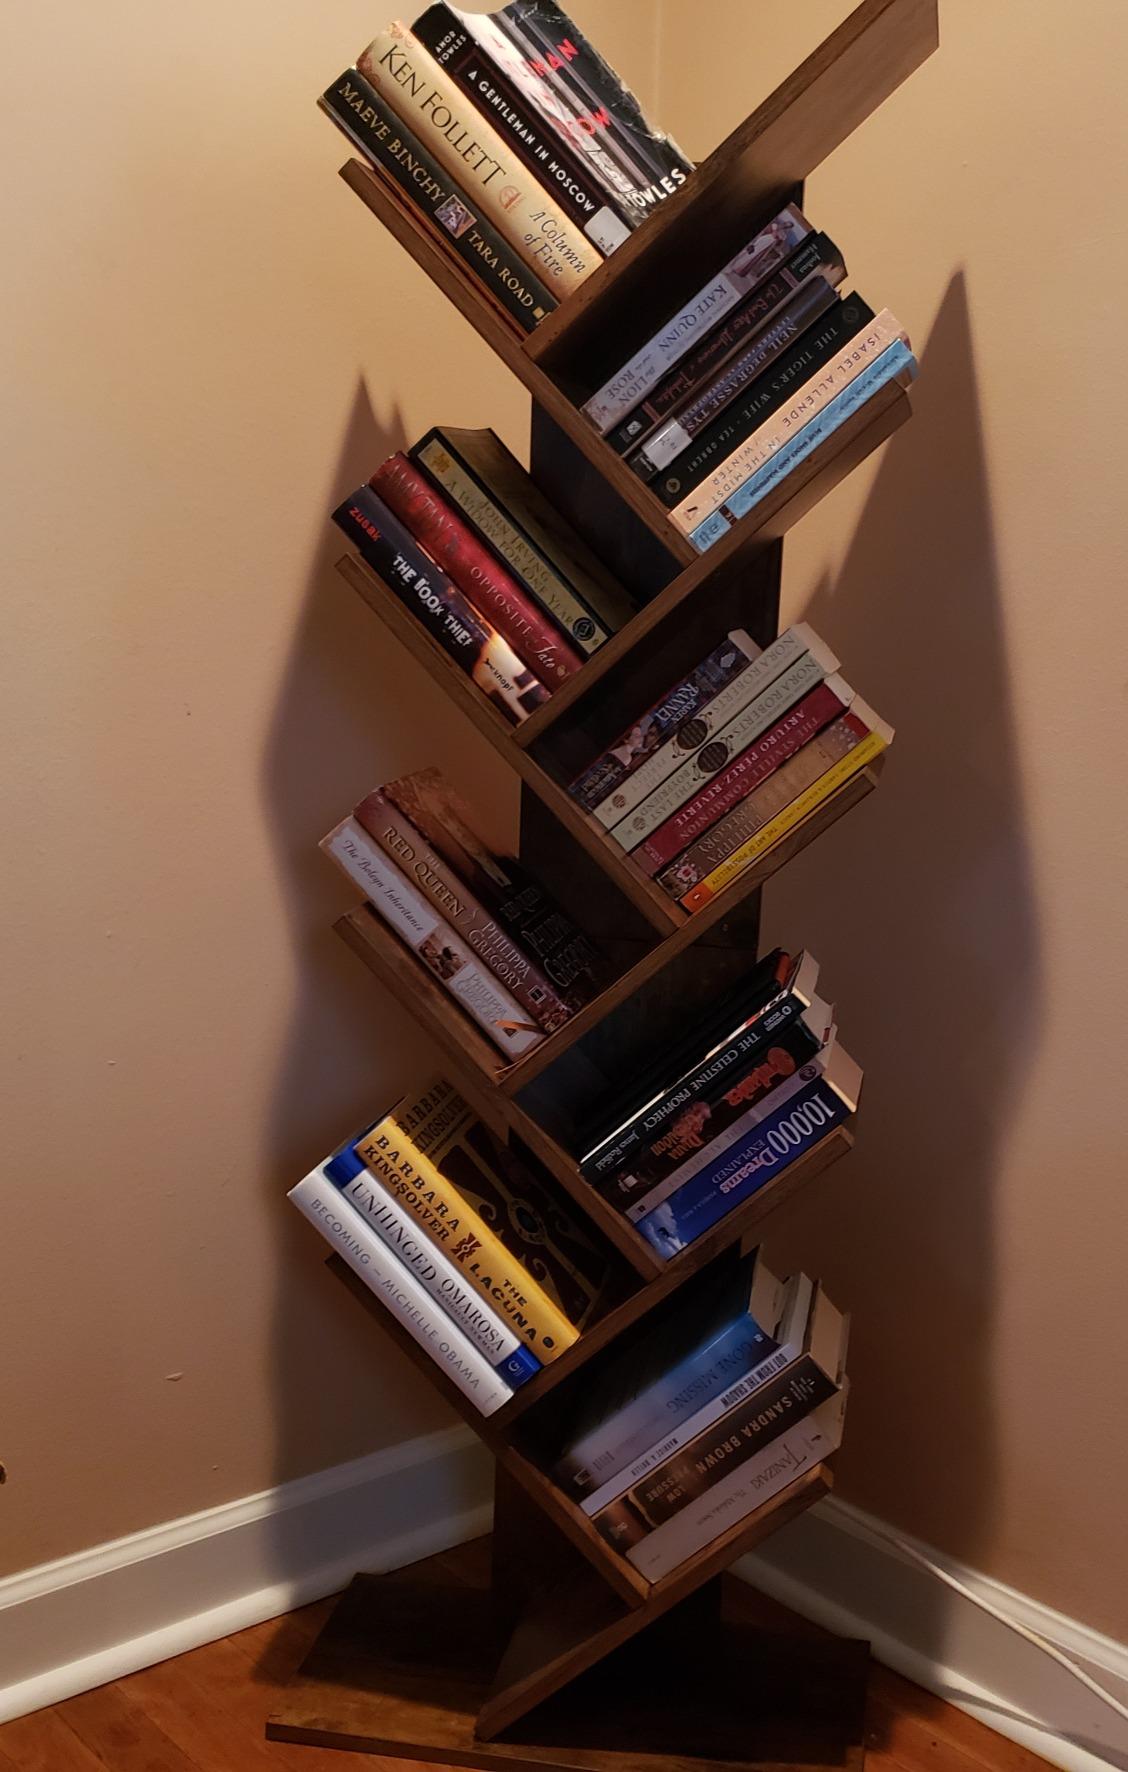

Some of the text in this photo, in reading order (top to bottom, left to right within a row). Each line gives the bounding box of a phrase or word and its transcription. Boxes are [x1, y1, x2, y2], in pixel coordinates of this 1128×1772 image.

[434, 33, 469, 65] TOWLES
[378, 44, 507, 189] KEN FOLLETT
[467, 68, 596, 214] A GENTLEMAN IN MOSCOW
[336, 80, 447, 204] MAEVE BINCHY
[520, 228, 567, 278] of Fire
[529, 206, 591, 274] A Column
[463, 228, 536, 309] TARA ROAD
[692, 282, 729, 317] KATE
[652, 308, 700, 353] QUINN
[765, 321, 798, 353] NEIL
[812, 325, 839, 351] THE
[835, 332, 881, 375] ISABEL
[602, 368, 637, 400] ROSE
[615, 373, 649, 406] LION
[769, 350, 814, 393] TIGER'S
[680, 406, 710, 435] TYS
[740, 390, 772, 420] WIFE
[779, 374, 837, 428] ALLENDE
[707, 435, 782, 505] IN THE MIDST
[709, 444, 754, 487] WINTER
[456, 491, 502, 541] WIDOW
[497, 539, 526, 569] FOR
[520, 564, 549, 595] ONE
[477, 498, 554, 582] JOHN IRVING
[387, 552, 419, 585] THE
[467, 563, 535, 638] OPPOSITE
[779, 658, 817, 693] NORA
[669, 698, 697, 724] KAREN
[729, 688, 783, 738] ROBERTS
[756, 708, 807, 754] ARTURO
[793, 714, 820, 739] THE
[748, 736, 795, 779] SEVILLE
[678, 775, 751, 842] COMMUNION
[340, 838, 427, 935] The Boleyn Inheritance
[380, 825, 466, 921] RED QUEEN
[464, 925, 525, 992] GREGORY
[478, 919, 534, 980] PHILIPPA
[639, 1028, 762, 1133] THE CELESTINE PROPHECY
[760, 1088, 837, 1158] 10,000
[373, 1134, 464, 1232] BARBARA
[708, 1137, 767, 1185] EXPLAINED
[716, 1145, 779, 1196] Dreams
[361, 1144, 452, 1243] KINGSOLVER
[345, 1179, 444, 1284] UNHINGED
[308, 1196, 483, 1390] BECOMING MICHELLE OBAMA
[436, 1274, 510, 1353] OMAROSA
[467, 1261, 542, 1341] LACUNA
[500, 1277, 528, 1308] THE
[663, 1338, 756, 1415] GONE MISSING
[742, 1373, 759, 1390] THE
[738, 1393, 794, 1440] SANDRA
[693, 1432, 742, 1475] BROWN
